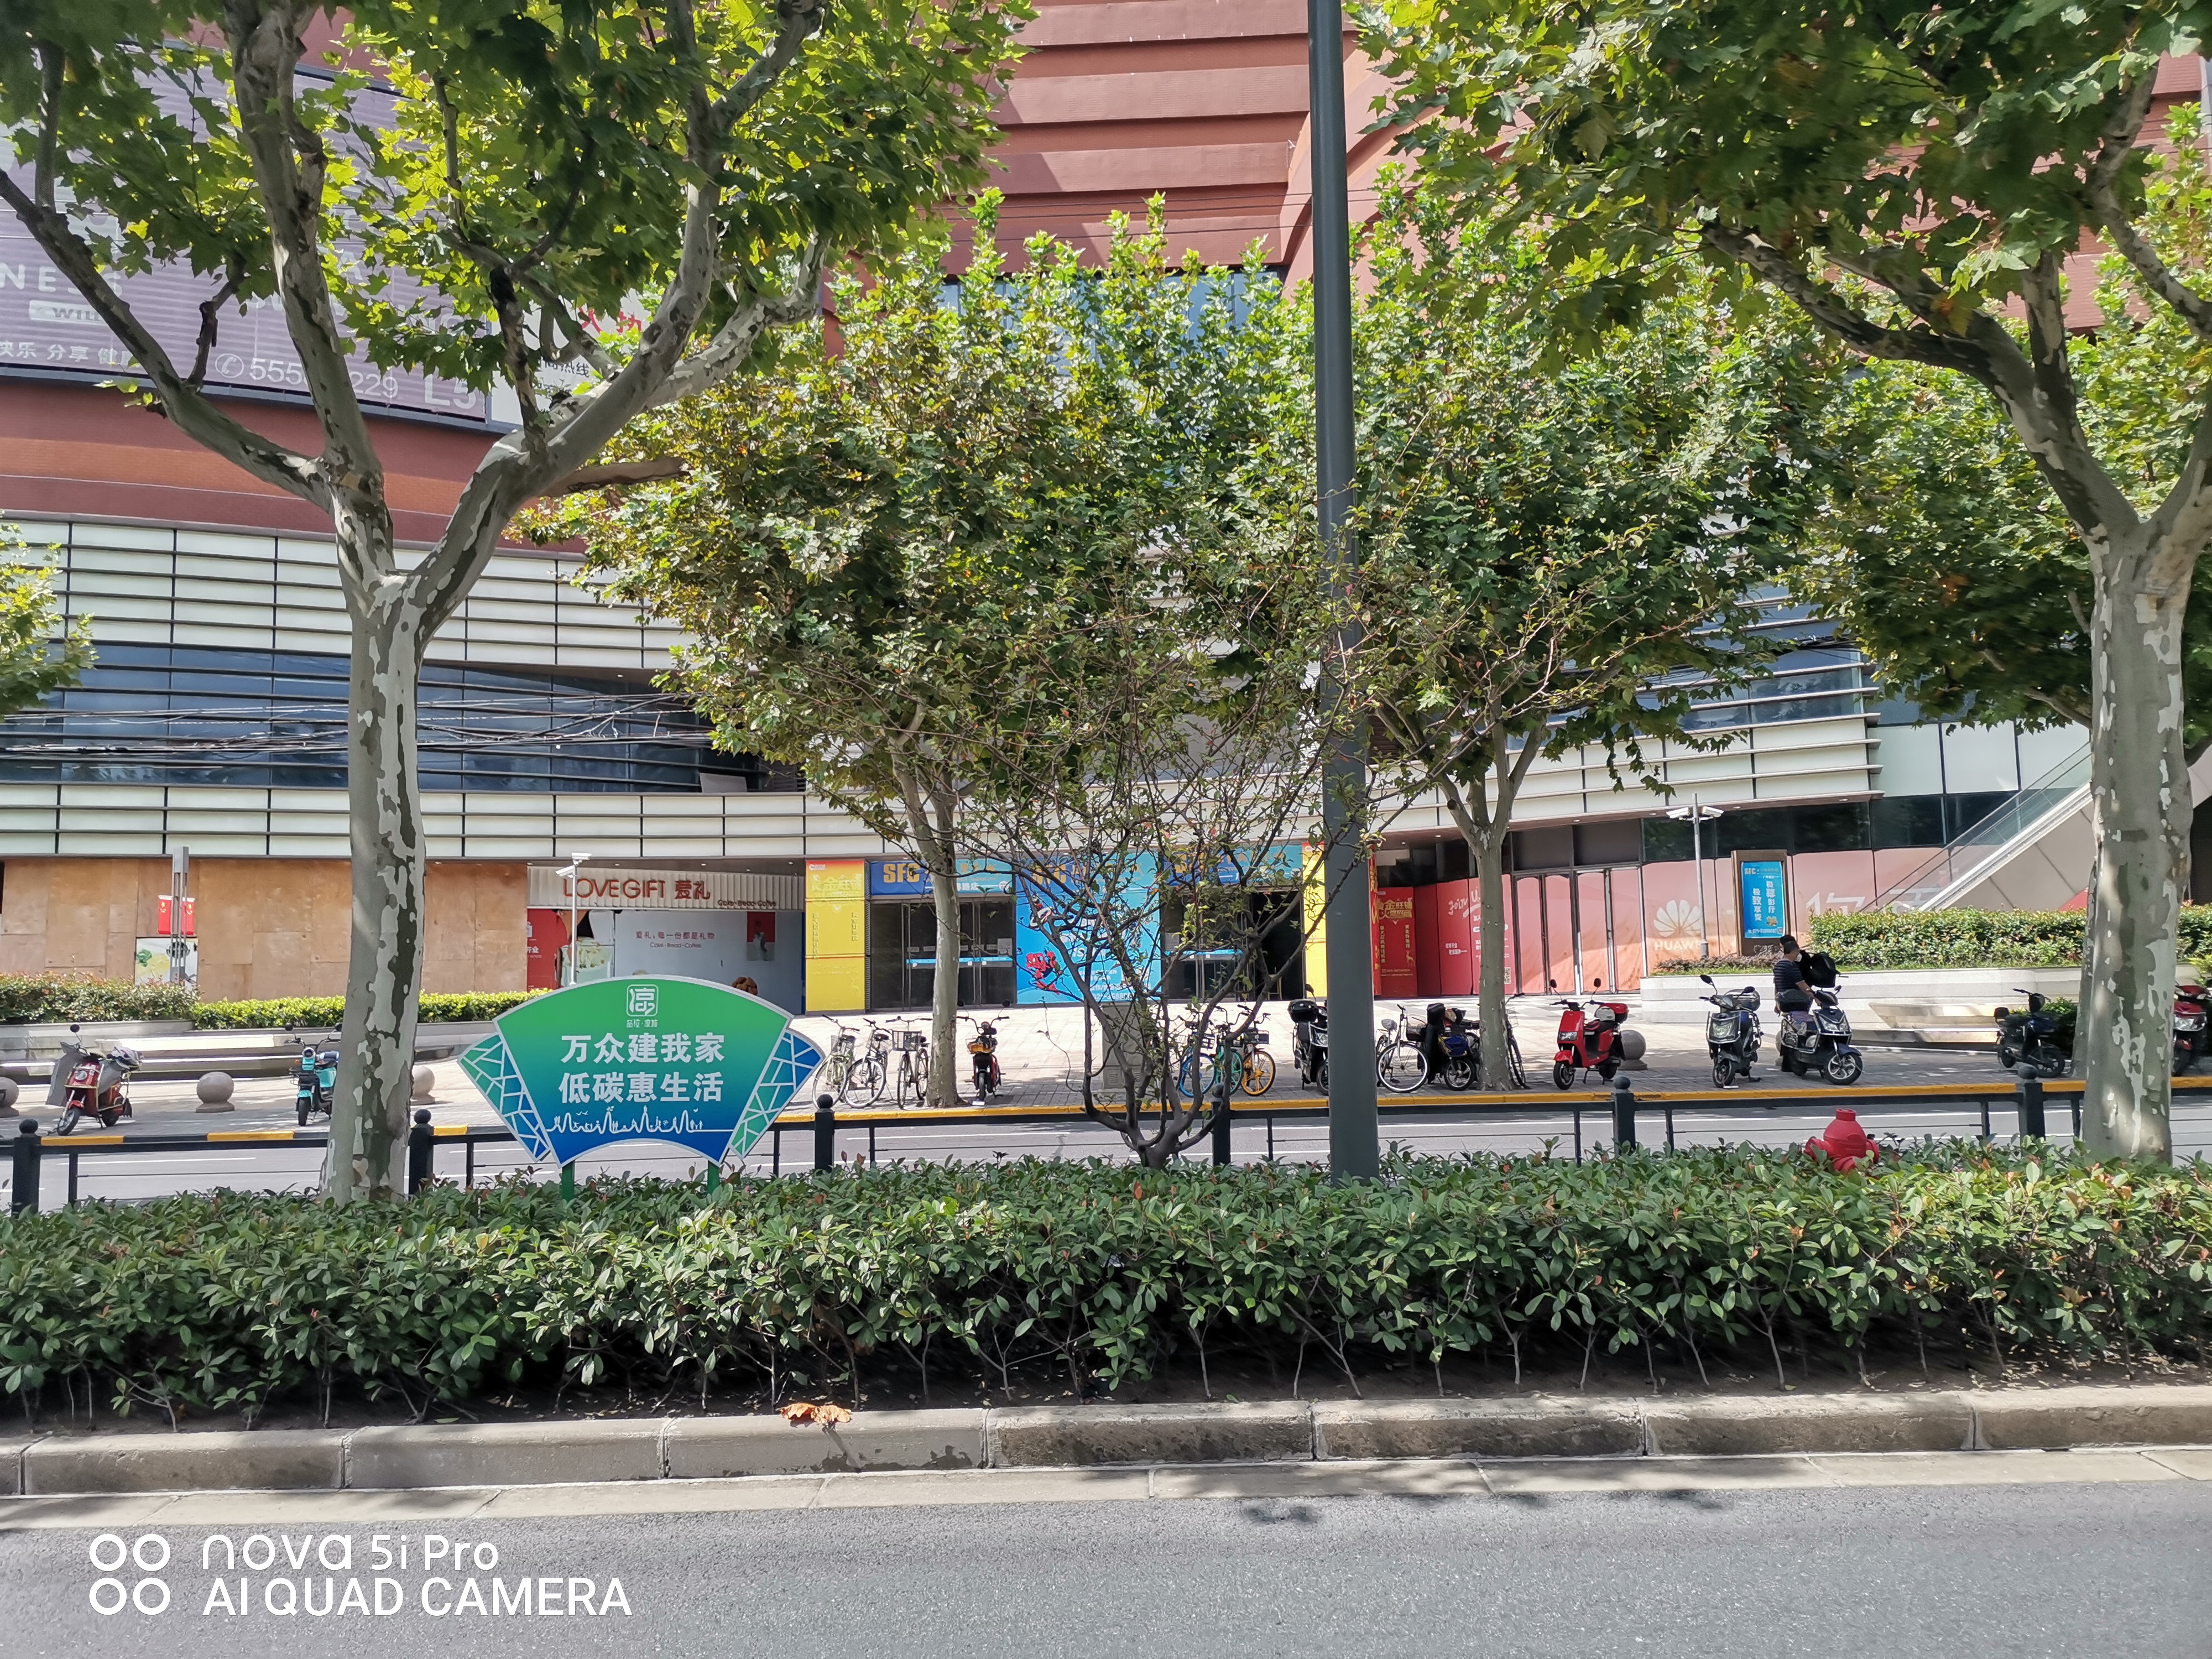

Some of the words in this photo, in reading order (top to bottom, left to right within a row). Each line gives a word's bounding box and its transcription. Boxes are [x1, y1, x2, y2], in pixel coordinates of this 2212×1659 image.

[46, 343, 89, 362] 分享
[883, 863, 920, 883] SFC
[674, 880, 711, 900] 爱礼
[561, 1032, 724, 1063] 万众建我家
[559, 1072, 723, 1103] 低碳惠生活
